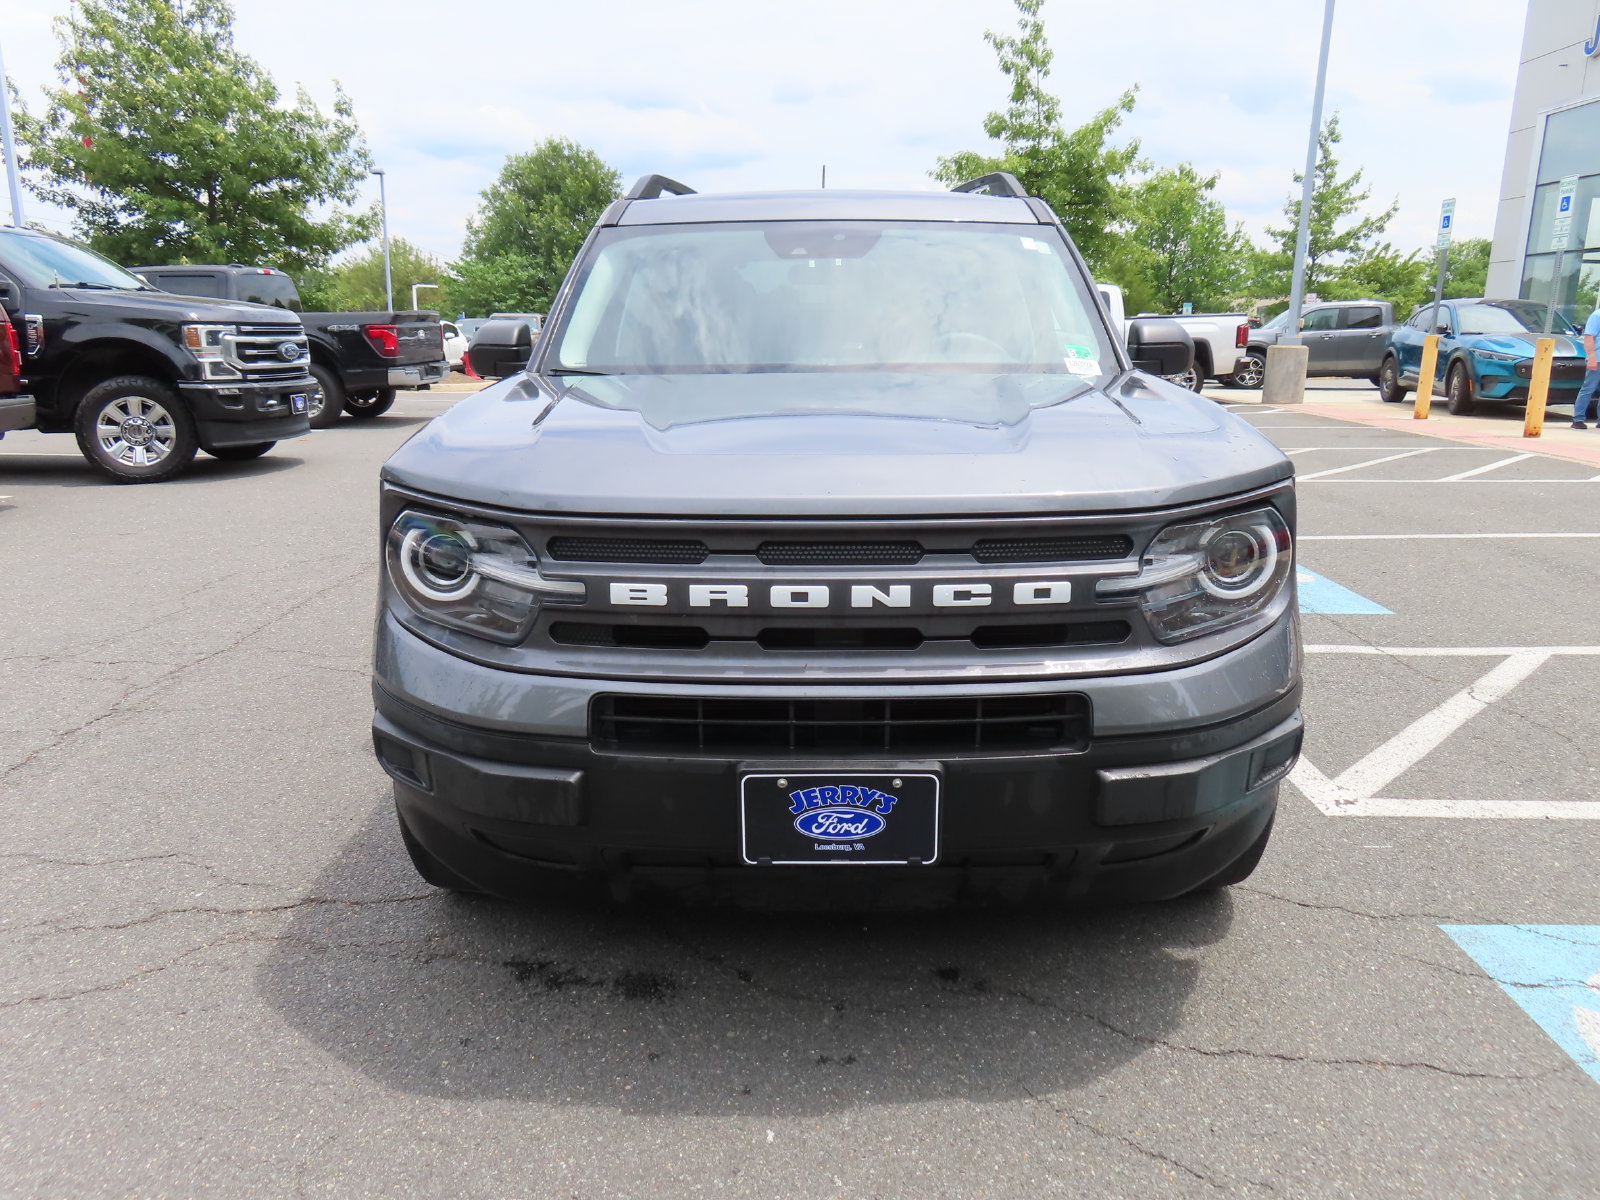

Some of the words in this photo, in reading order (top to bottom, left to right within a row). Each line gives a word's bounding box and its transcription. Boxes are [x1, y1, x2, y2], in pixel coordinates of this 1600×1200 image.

[609, 581, 1072, 608] BRONCO
[788, 785, 898, 814] JERRY'S
[811, 812, 869, 834] Ford
